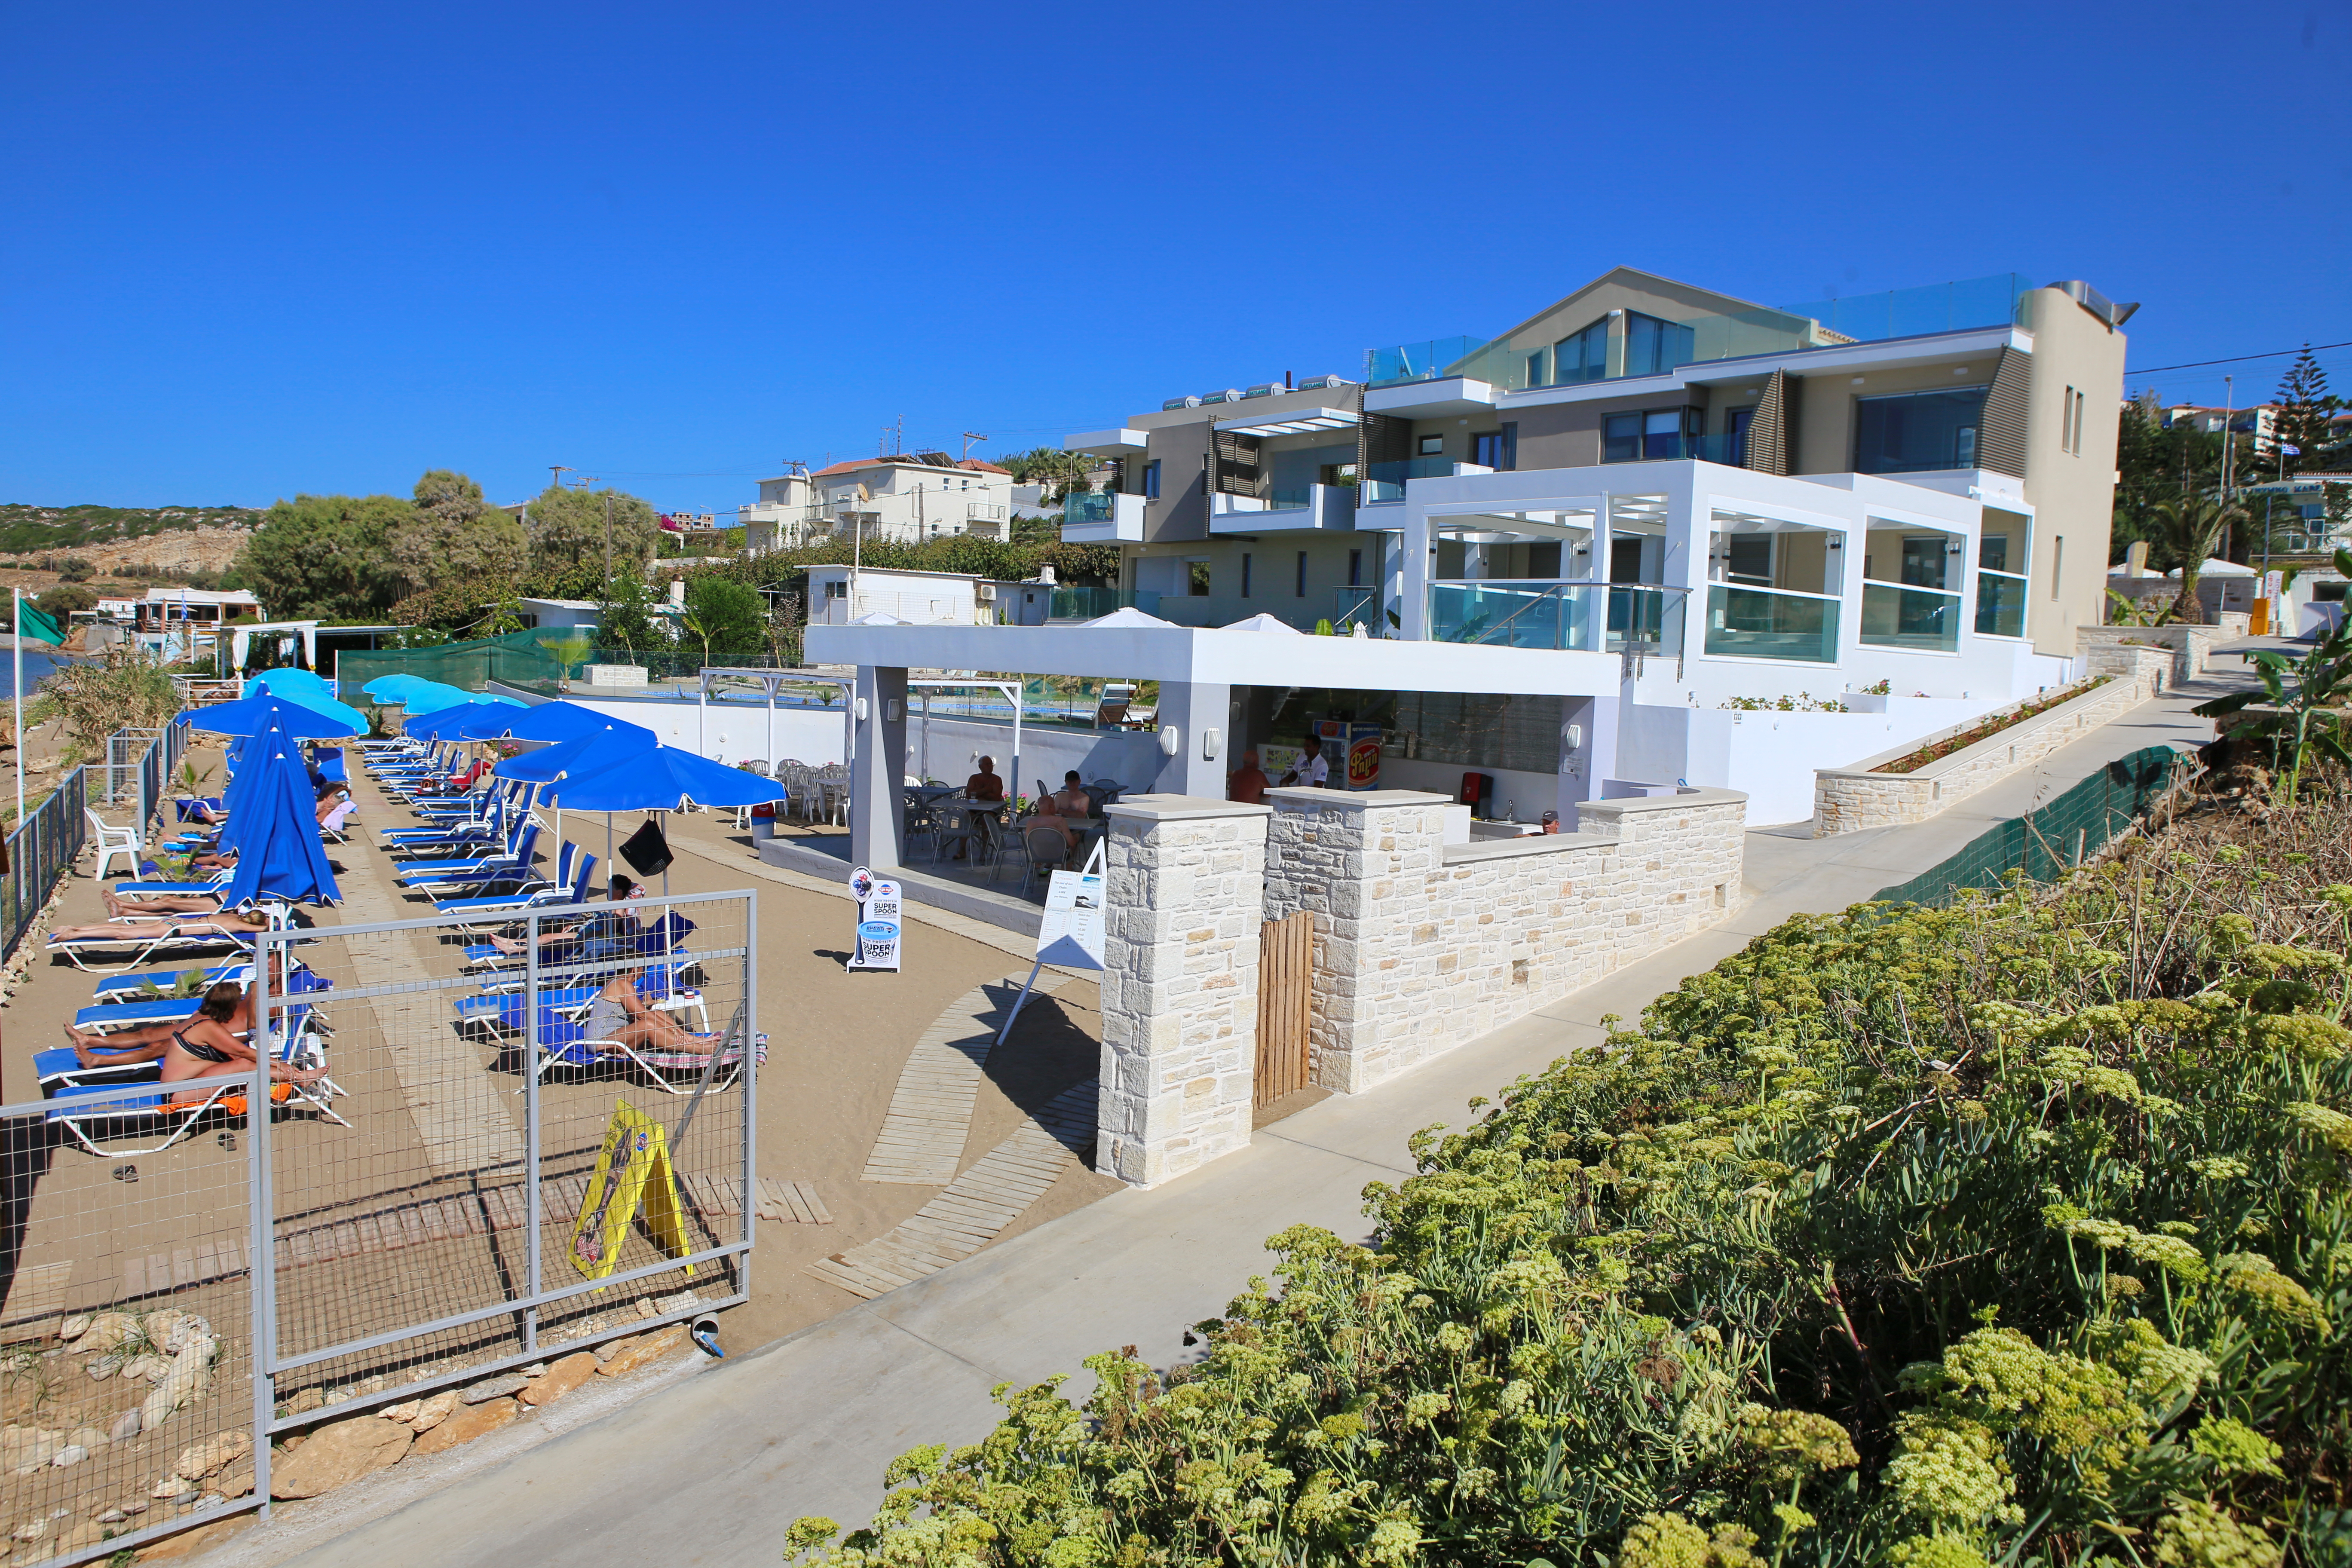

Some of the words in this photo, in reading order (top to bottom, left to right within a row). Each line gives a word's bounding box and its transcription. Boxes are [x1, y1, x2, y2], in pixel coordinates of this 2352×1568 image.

[2271, 578, 2280, 609] Station
[863, 941, 890, 951] SUPER
[864, 948, 890, 957] SPOON
